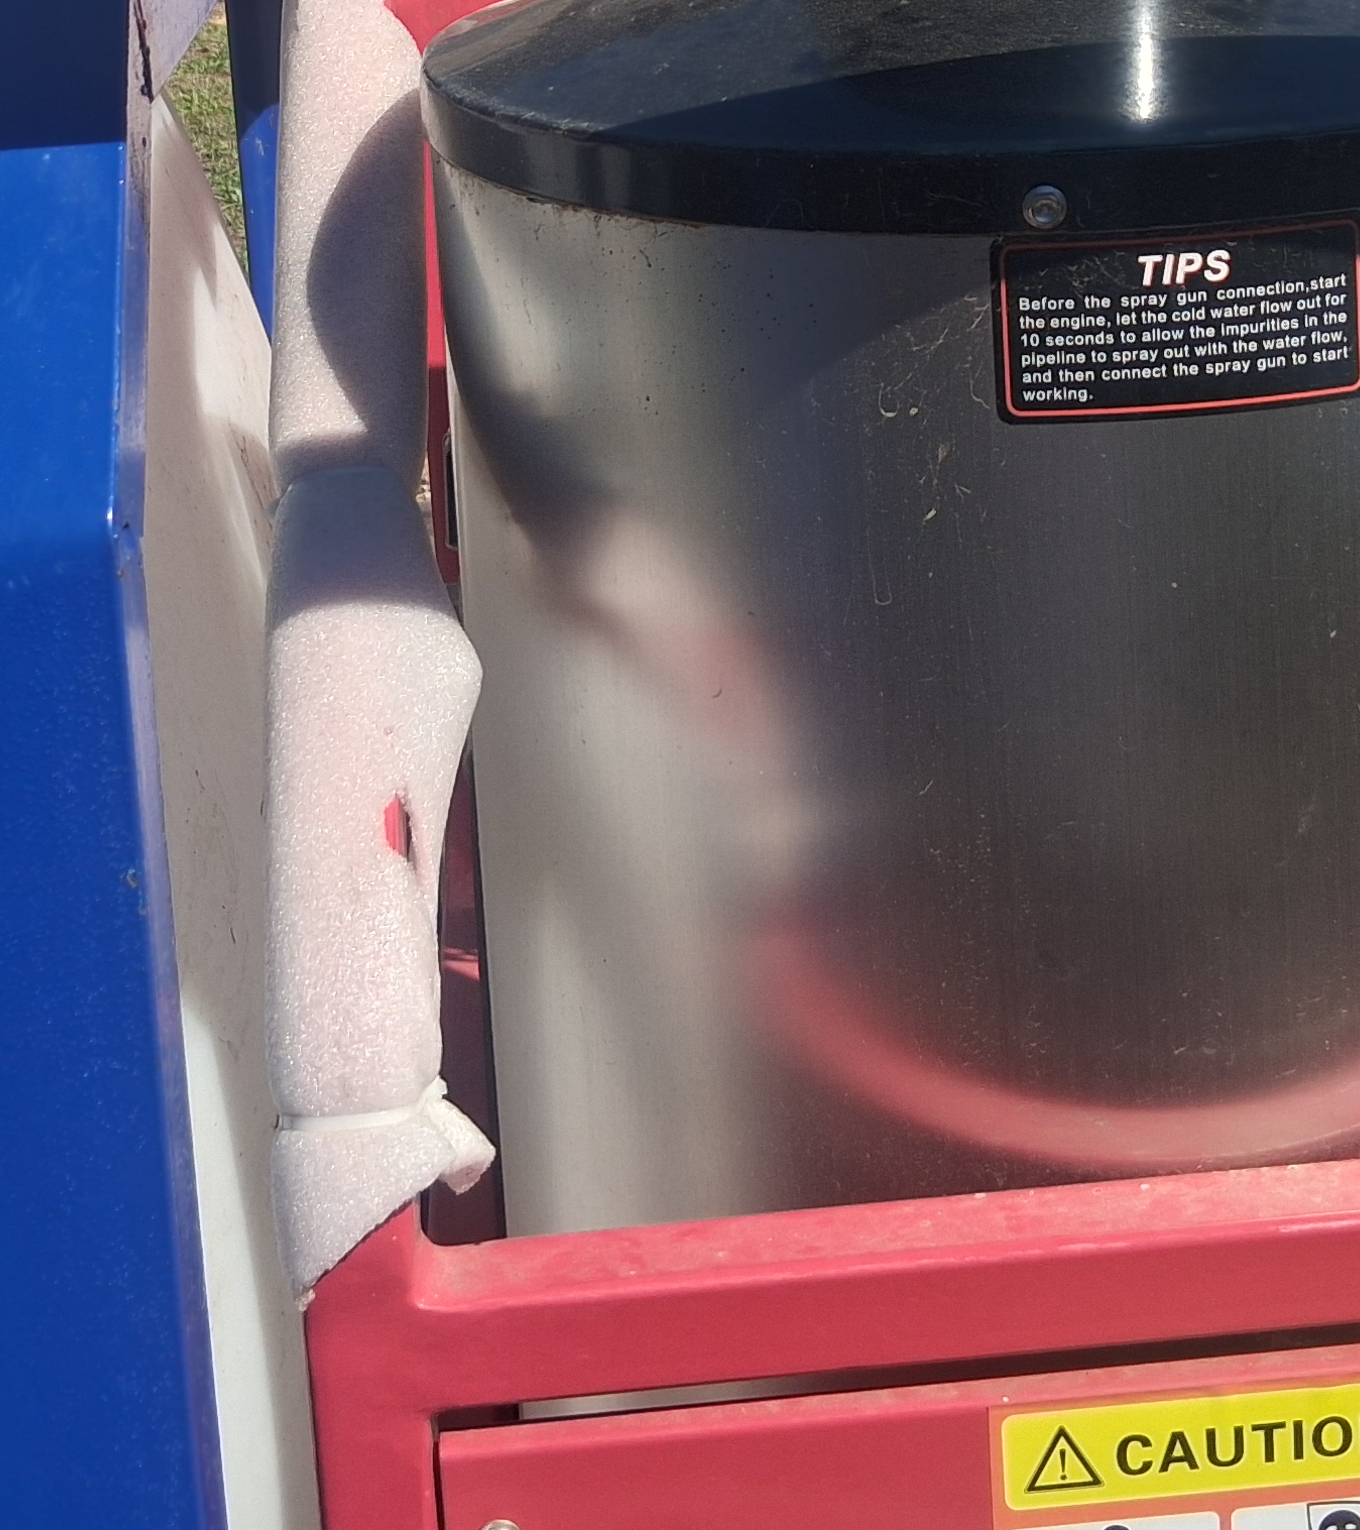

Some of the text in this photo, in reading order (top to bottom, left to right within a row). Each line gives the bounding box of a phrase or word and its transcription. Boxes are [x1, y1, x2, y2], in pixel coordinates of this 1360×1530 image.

[1138, 249, 1231, 287] TIPS
[1019, 296, 1075, 311] Before
[1084, 295, 1111, 309] the
[1120, 293, 1168, 309] spray
[1176, 291, 1208, 306] gun
[1019, 293, 1348, 330] the engine, let the cold water flow out for
[1021, 311, 1348, 347] 10 seconds to allow the impurities in the
[1021, 329, 1348, 368] pipeline to spray out with the water flow,
[1022, 346, 1349, 384] and then connect the spray gun to start
[1022, 386, 1095, 403] working.
